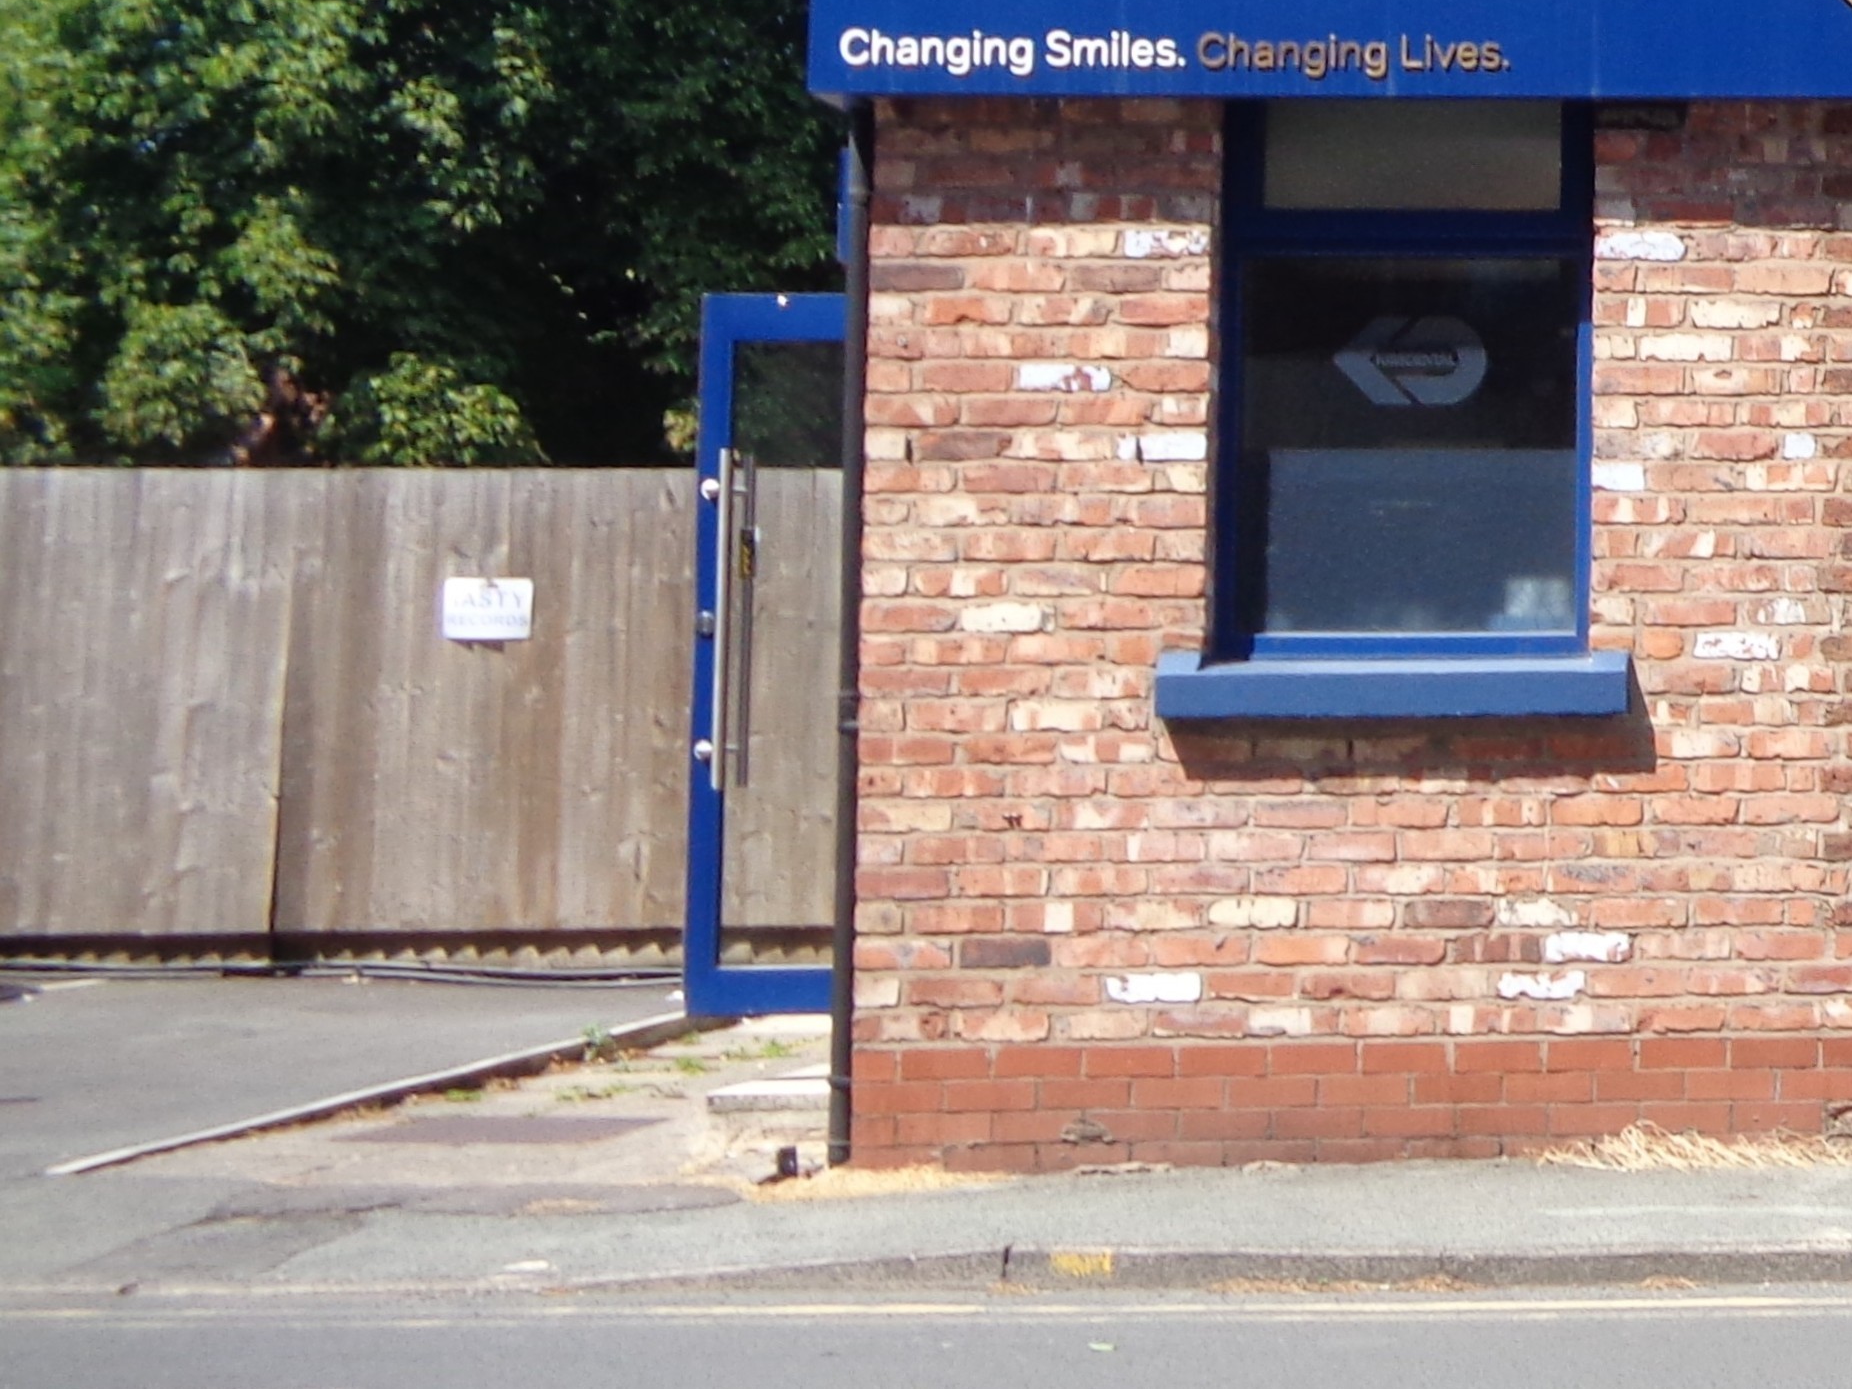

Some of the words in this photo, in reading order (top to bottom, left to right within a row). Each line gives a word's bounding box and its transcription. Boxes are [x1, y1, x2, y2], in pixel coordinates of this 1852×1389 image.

[839, 27, 1035, 77] Changing
[1045, 28, 1187, 69] Smiles.
[1197, 31, 1390, 79] Changing
[1400, 34, 1511, 72] Lives.
